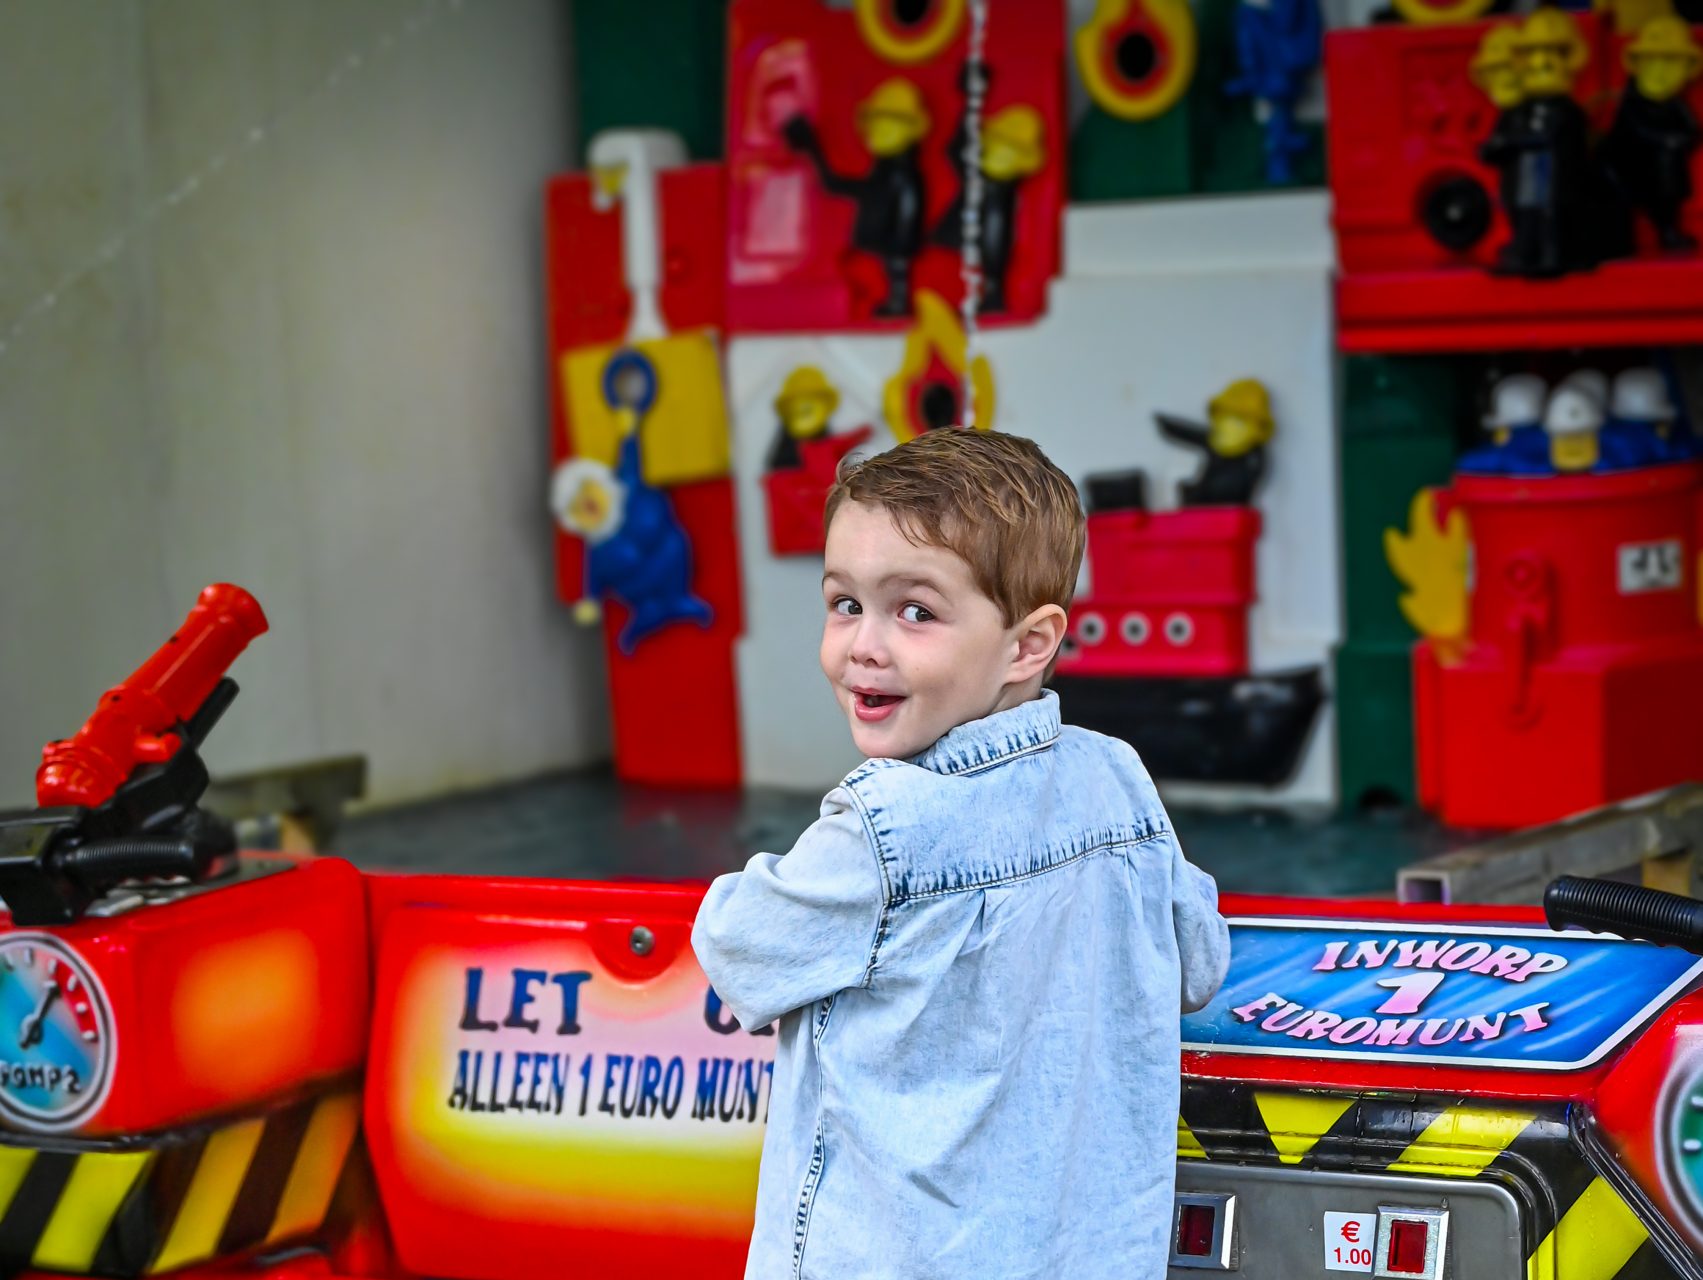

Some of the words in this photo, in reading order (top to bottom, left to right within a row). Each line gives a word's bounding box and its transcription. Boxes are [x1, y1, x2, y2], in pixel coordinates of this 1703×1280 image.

[1312, 939, 1568, 982] INWORP
[459, 966, 593, 1035] LET
[704, 983, 775, 1036] O
[1376, 971, 1446, 1015] 1
[1232, 992, 1550, 1046] EUROMUNT
[448, 1048, 570, 1116] ALLEEN
[578, 1053, 594, 1117] 1
[598, 1054, 685, 1119] EURO
[1340, 1220, 1361, 1243] €
[1333, 1246, 1372, 1266] 1.00
